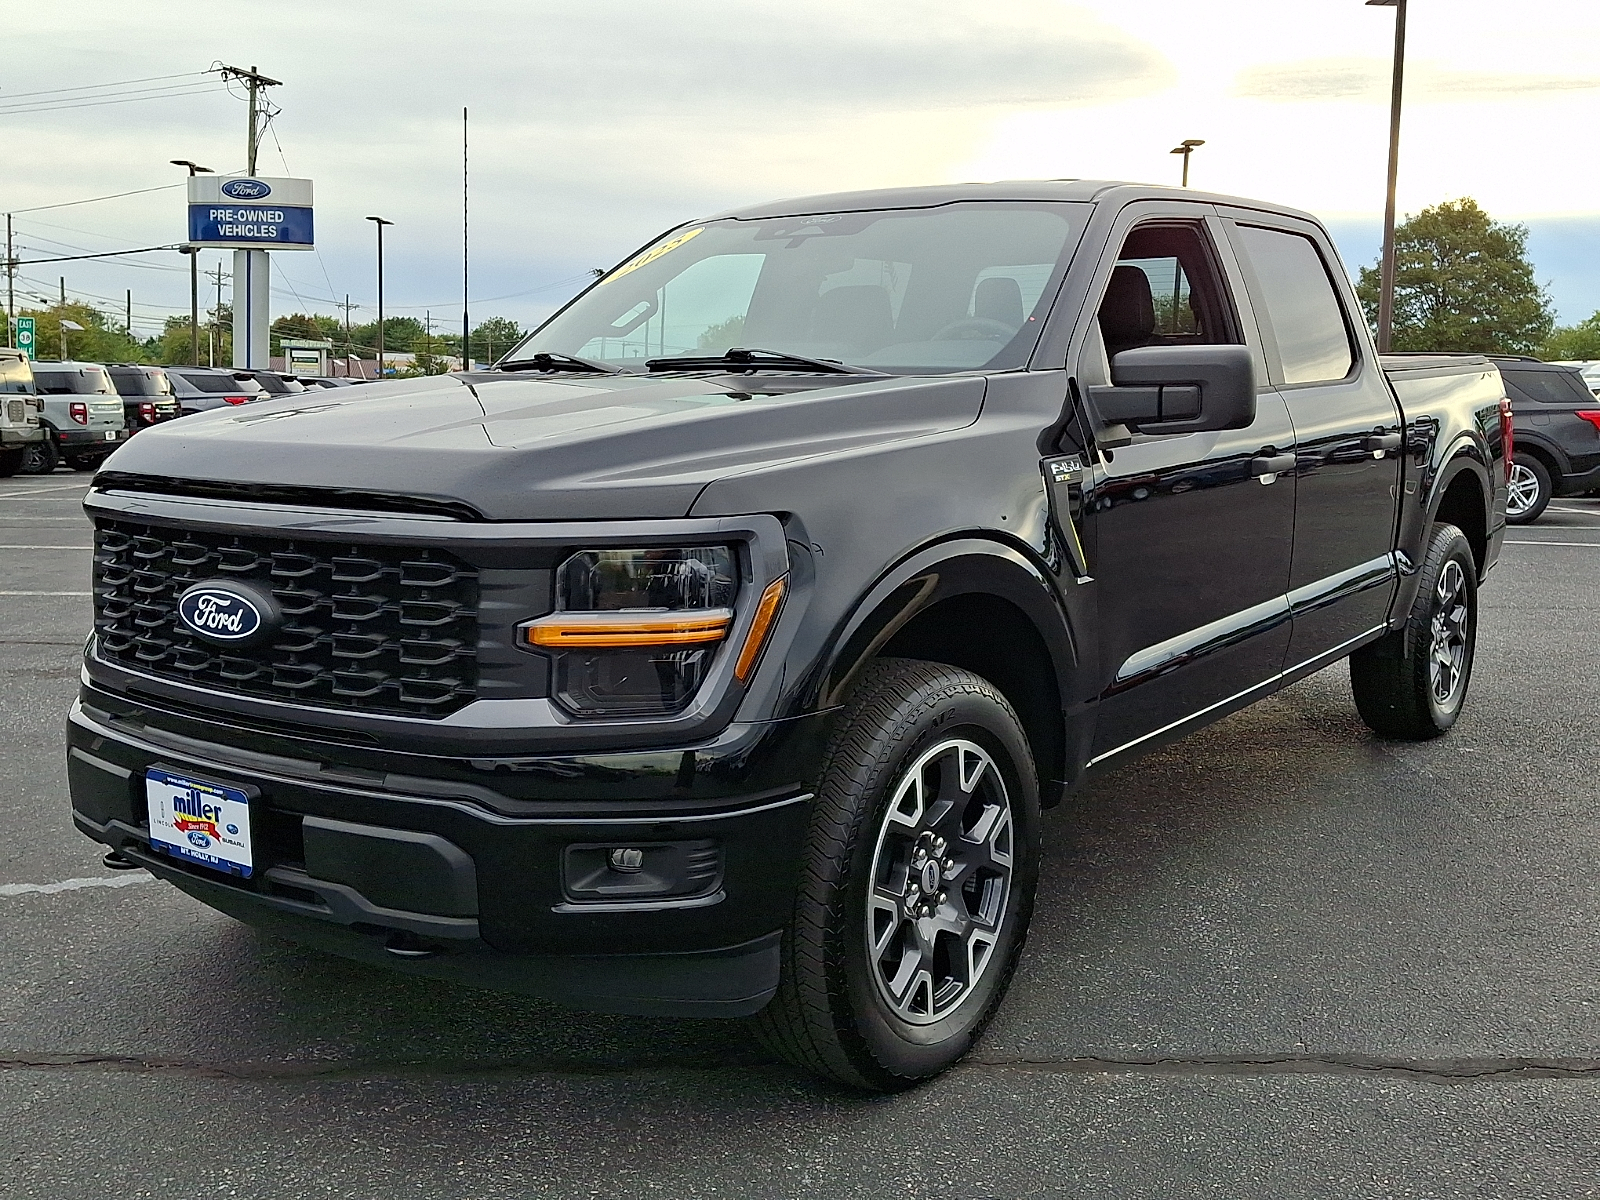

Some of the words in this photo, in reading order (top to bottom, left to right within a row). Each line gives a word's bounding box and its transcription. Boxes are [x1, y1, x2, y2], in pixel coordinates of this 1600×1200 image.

[231, 182, 260, 196] Ford
[209, 209, 284, 223] PRE-OWNED
[218, 224, 277, 237] VEHICLES
[19, 320, 32, 328] EAST
[193, 594, 244, 632] Ford
[173, 789, 222, 823] miller
[191, 832, 208, 847] Ford
[221, 838, 245, 848] SUBARU
